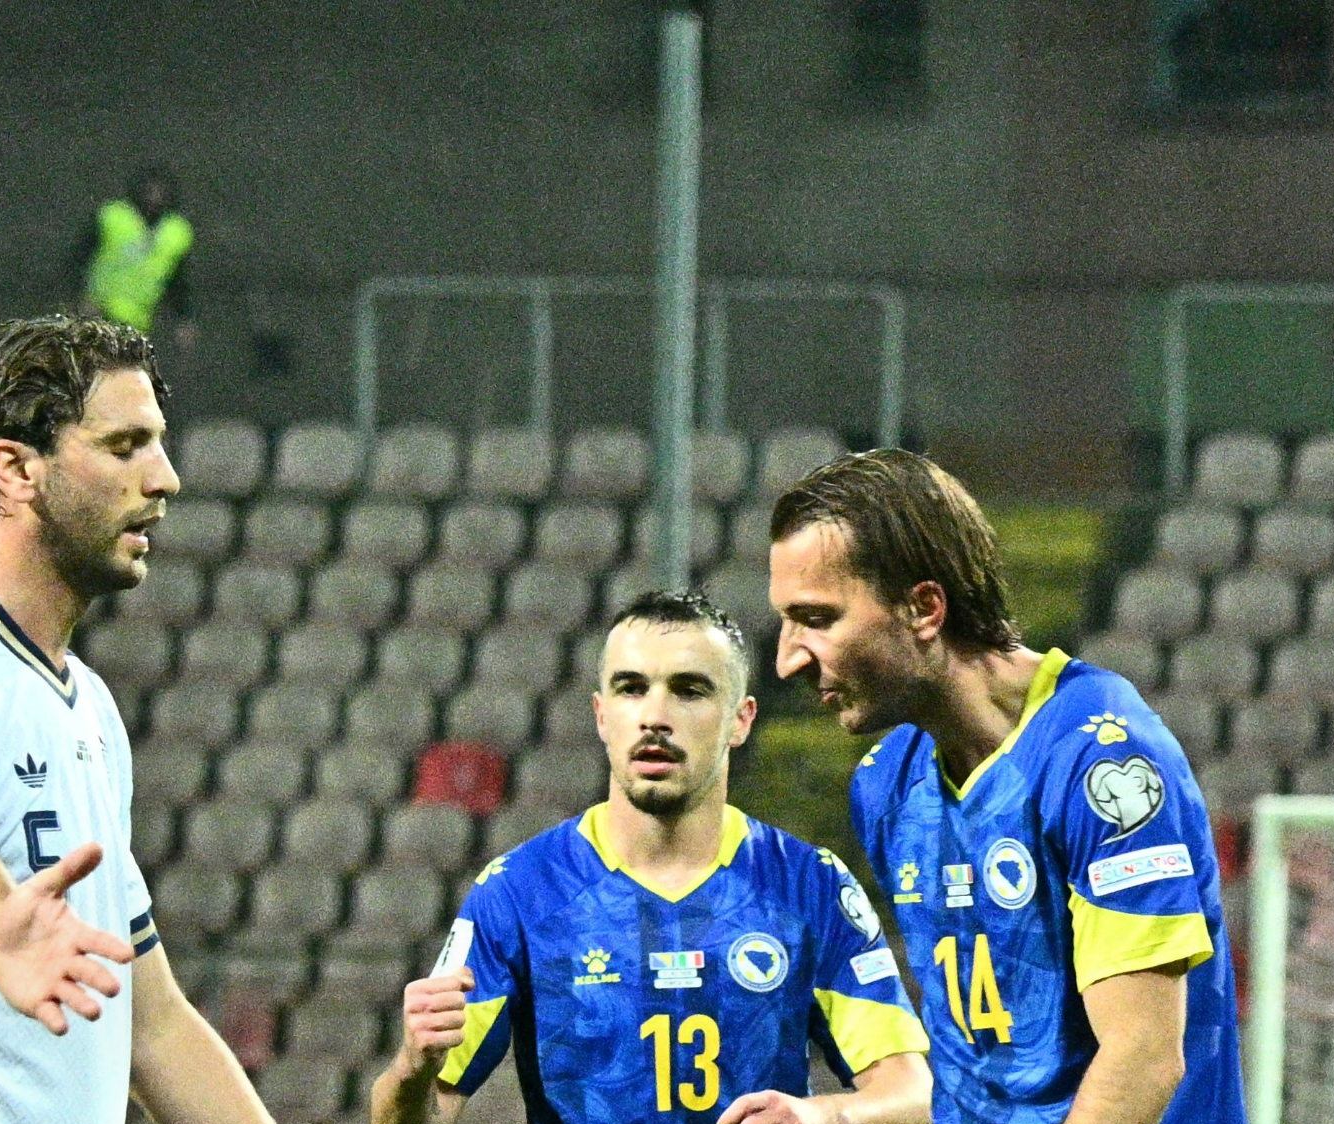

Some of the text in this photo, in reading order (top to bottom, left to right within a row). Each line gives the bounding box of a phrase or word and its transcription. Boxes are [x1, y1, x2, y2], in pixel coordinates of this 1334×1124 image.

[1093, 854, 1187, 884] FOUNDATION
[933, 933, 1014, 1044] 14
[639, 1013, 720, 1112] 13
